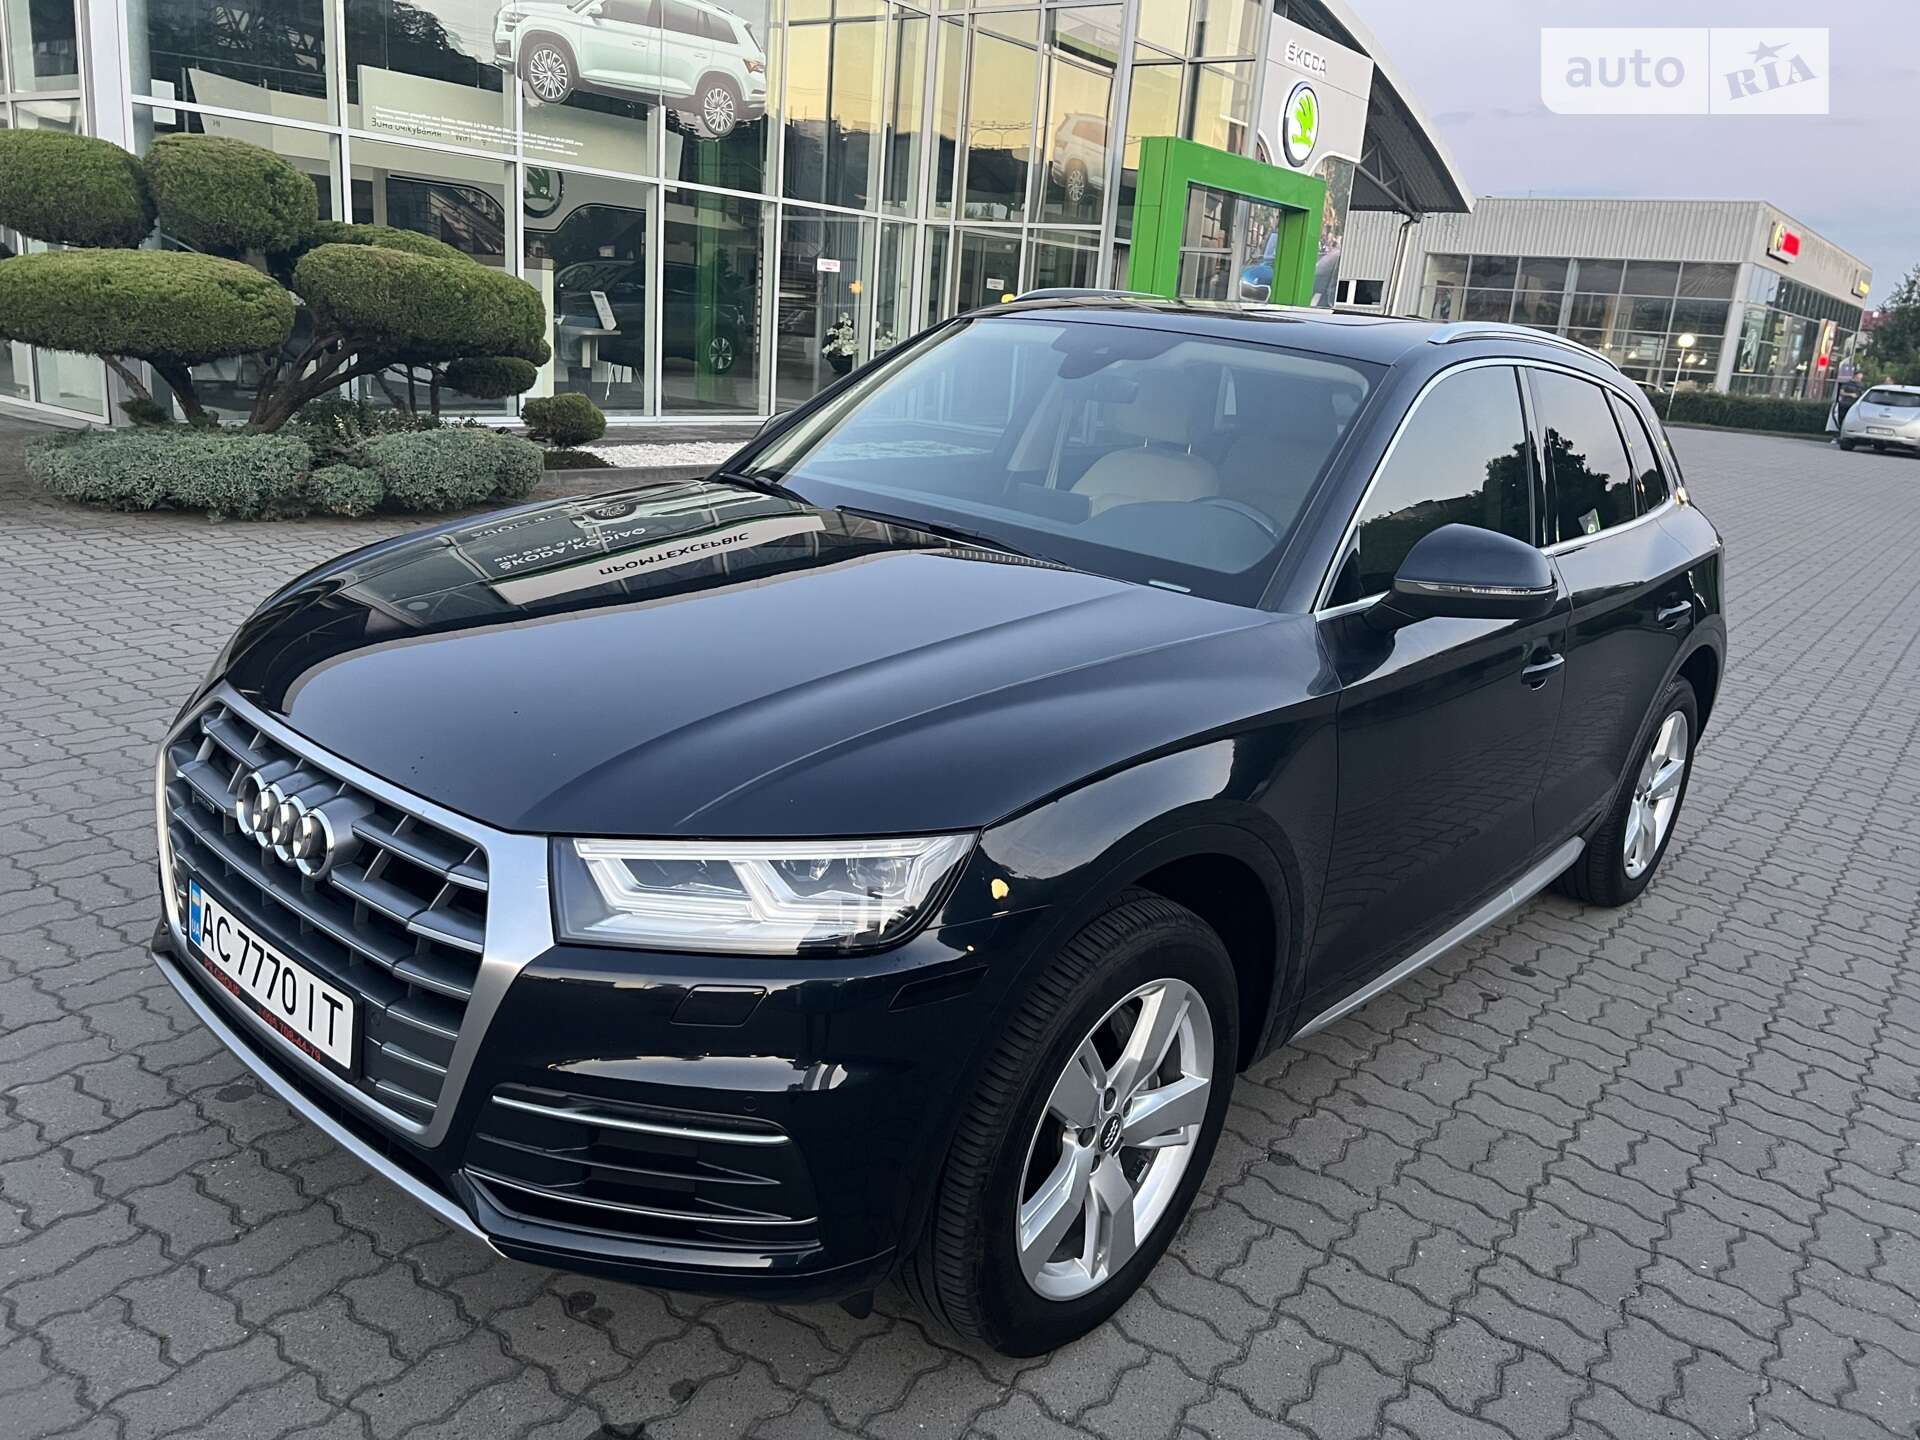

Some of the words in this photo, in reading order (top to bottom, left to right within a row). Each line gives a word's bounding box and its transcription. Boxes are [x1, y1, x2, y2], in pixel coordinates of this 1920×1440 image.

[1287, 41, 1327, 75] ŠKODA
[201, 901, 232, 963] AC
[237, 928, 297, 1016] 7770
[308, 982, 344, 1047] IT
